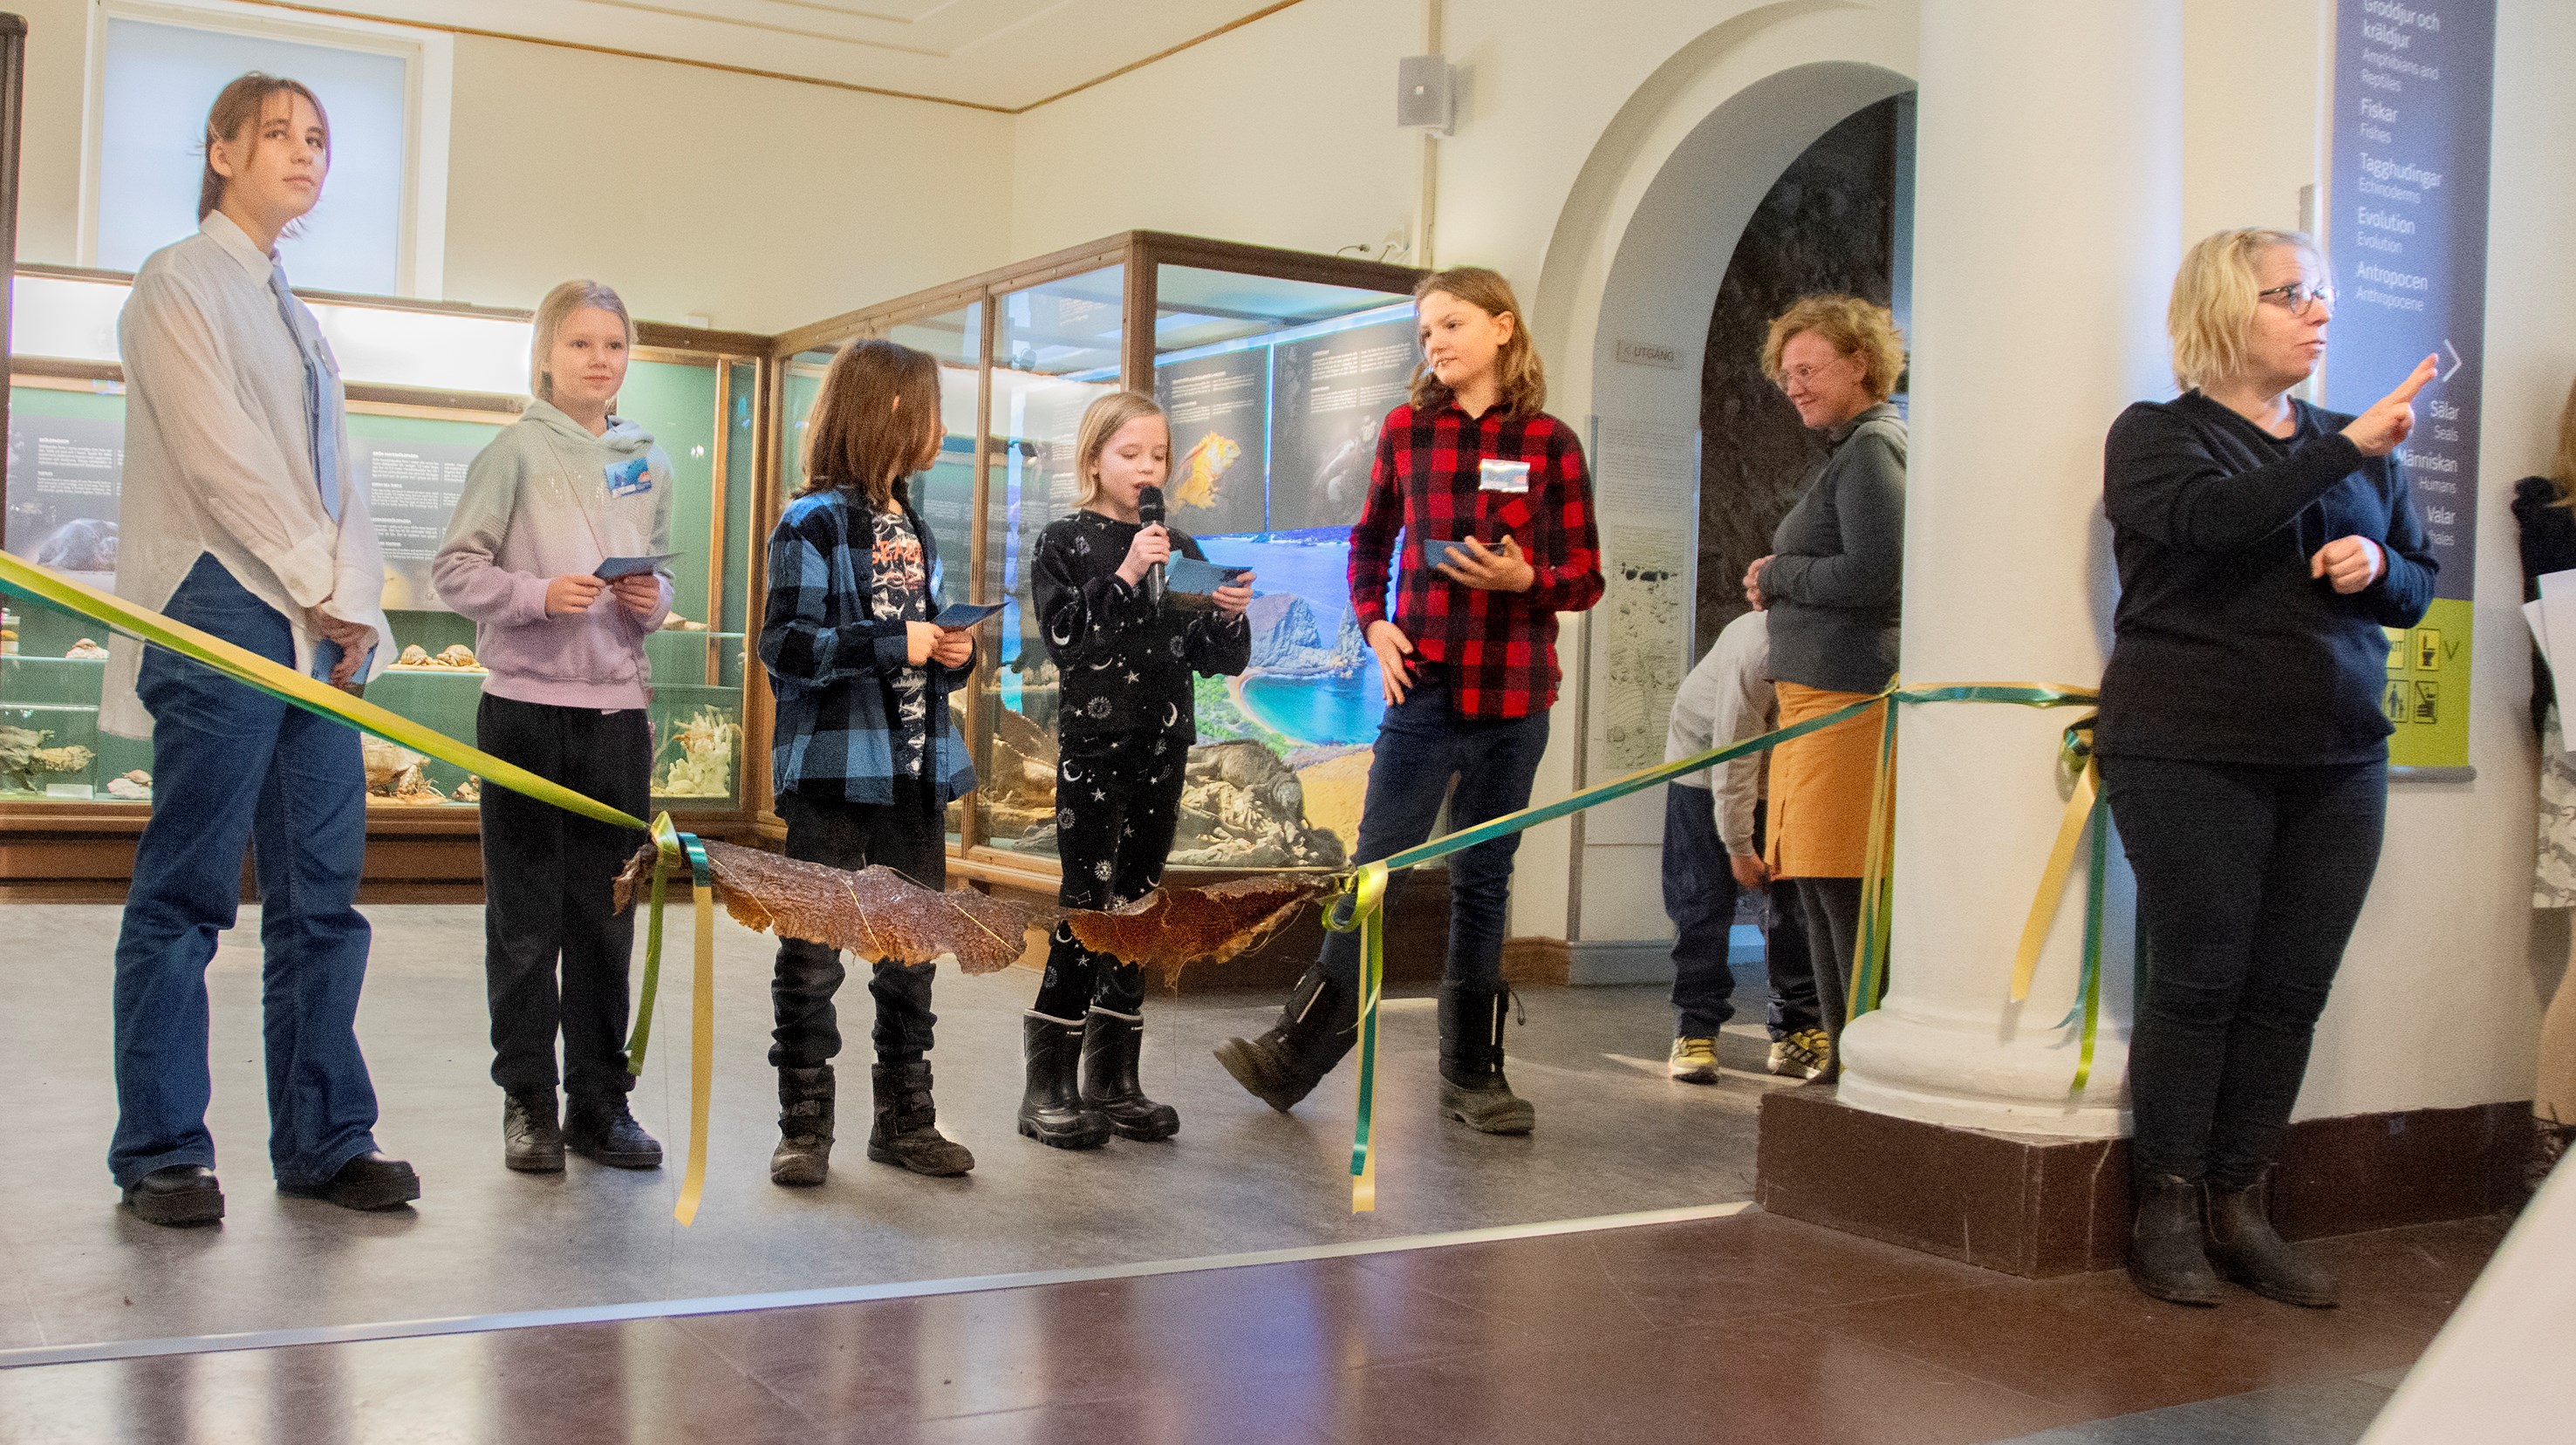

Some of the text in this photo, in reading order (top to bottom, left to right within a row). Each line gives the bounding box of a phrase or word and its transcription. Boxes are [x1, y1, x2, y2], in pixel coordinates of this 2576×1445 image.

[2417, 13, 2440, 31] och
[2363, 18, 2411, 50] kräldjur
[2420, 66, 2439, 80] and
[2361, 98, 2398, 122] Fiskar
[2360, 122, 2391, 144] Fishes
[2360, 152, 2443, 190] Tagghudingar
[2359, 176, 2422, 204] Echinoderms
[2358, 206, 2415, 235] Evolution
[2358, 230, 2402, 253] Evolution
[2357, 261, 2429, 290] Antropocen
[2356, 285, 2424, 311] Anthropocene
[1634, 346, 1675, 362] UTGÅNG
[2430, 399, 2460, 420] Sälar
[2434, 424, 2459, 442] Seals
[2419, 476, 2457, 494] Humans
[2427, 505, 2456, 525] Valar
